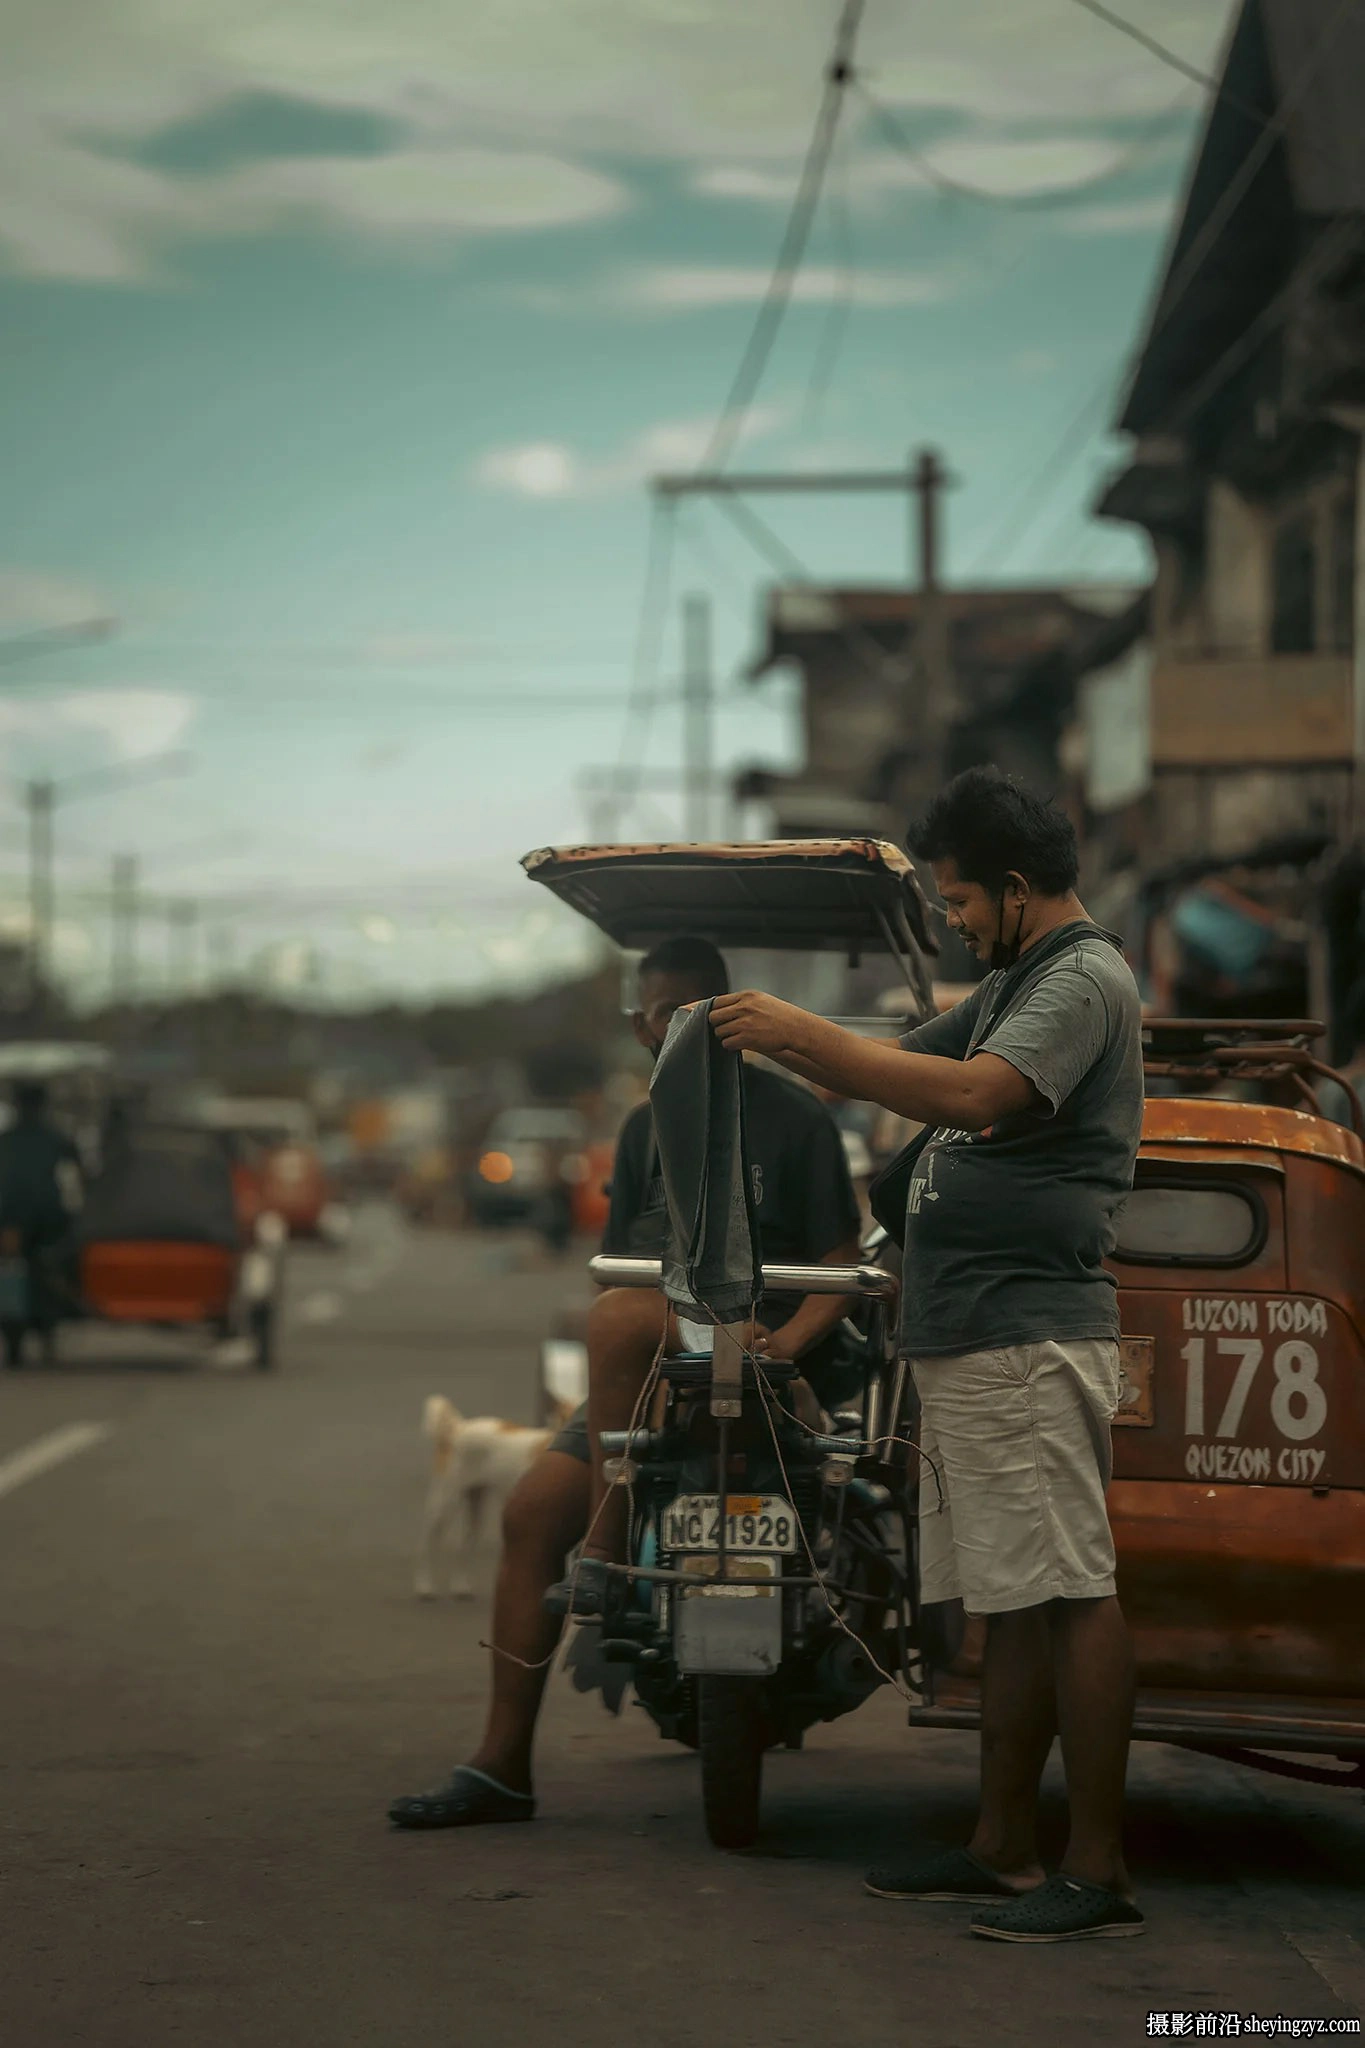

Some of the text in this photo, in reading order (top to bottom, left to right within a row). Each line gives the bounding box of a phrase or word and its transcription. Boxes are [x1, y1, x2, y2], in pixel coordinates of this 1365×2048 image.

[1182, 1298, 1328, 1338] LUZON TODA
[1180, 1338, 1328, 1441] 178
[1185, 1444, 1326, 1481] QUEZON CITY
[707, 1515, 790, 1547] 41928
